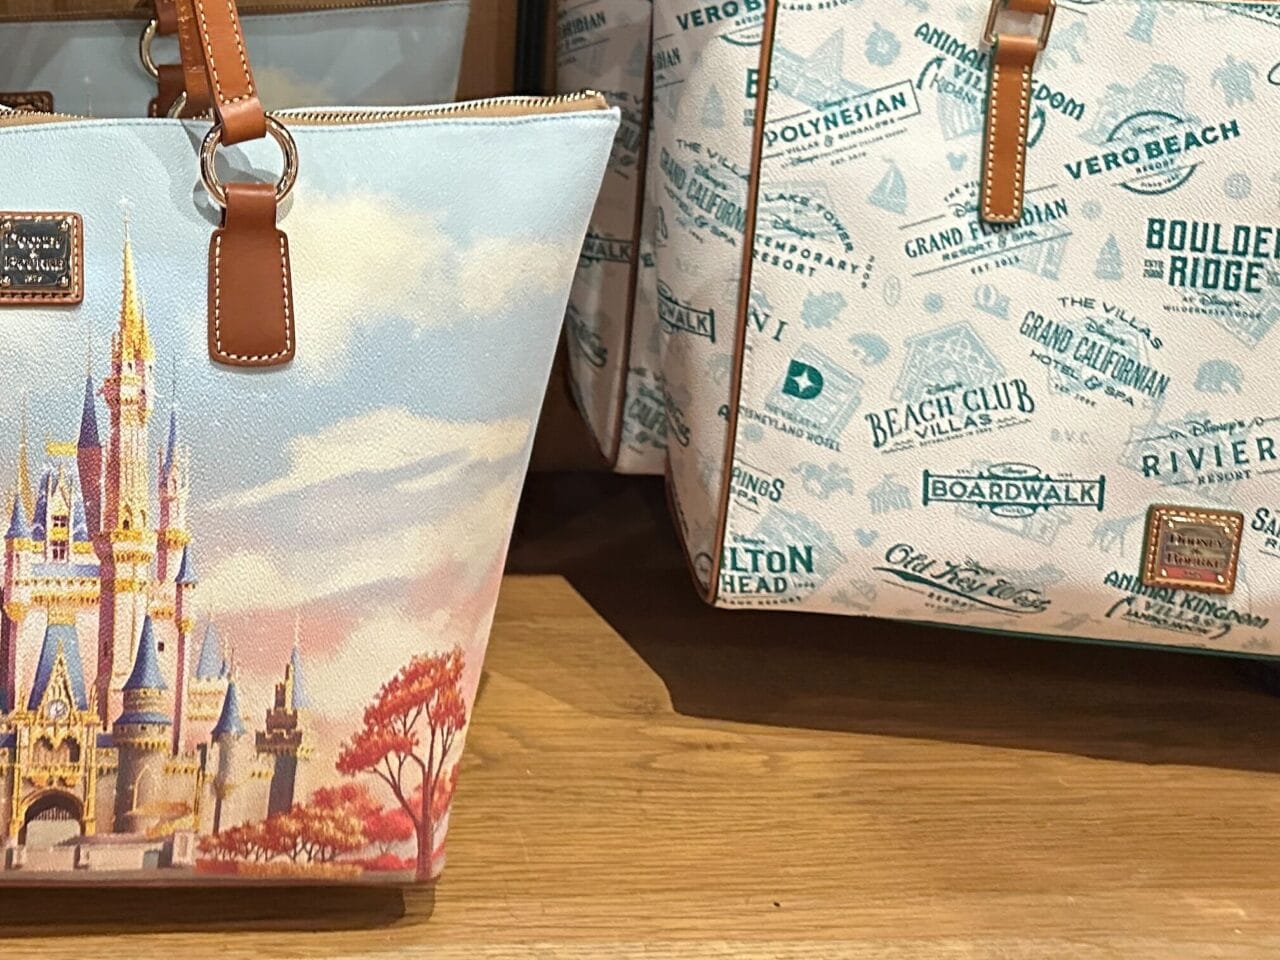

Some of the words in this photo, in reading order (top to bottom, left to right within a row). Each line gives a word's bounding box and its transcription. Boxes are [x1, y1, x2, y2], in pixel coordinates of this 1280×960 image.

[676, 0, 740, 31] VERO
[914, 22, 988, 72] ANIMAL
[764, 92, 907, 147] POLYNESIAN
[1064, 146, 1140, 180] VERO
[1144, 119, 1241, 160] BEACH
[904, 227, 964, 259] GRAND
[1168, 255, 1264, 293] RIDGE
[1056, 296, 1097, 310] THE
[1102, 301, 1164, 350] VILLAS
[1019, 310, 1074, 354] GRAND
[1072, 336, 1171, 400] CALIFORNIAN
[1029, 349, 1082, 381] HOTEL
[1104, 385, 1135, 408] SPA
[864, 396, 955, 449] BEACH
[962, 378, 1036, 415] CLUB
[914, 413, 993, 440] VILLAS
[1141, 436, 1277, 478] RIVIER
[931, 479, 1097, 503] BOARDWALK
[885, 543, 937, 574] Old
[721, 573, 789, 594] HEAD
